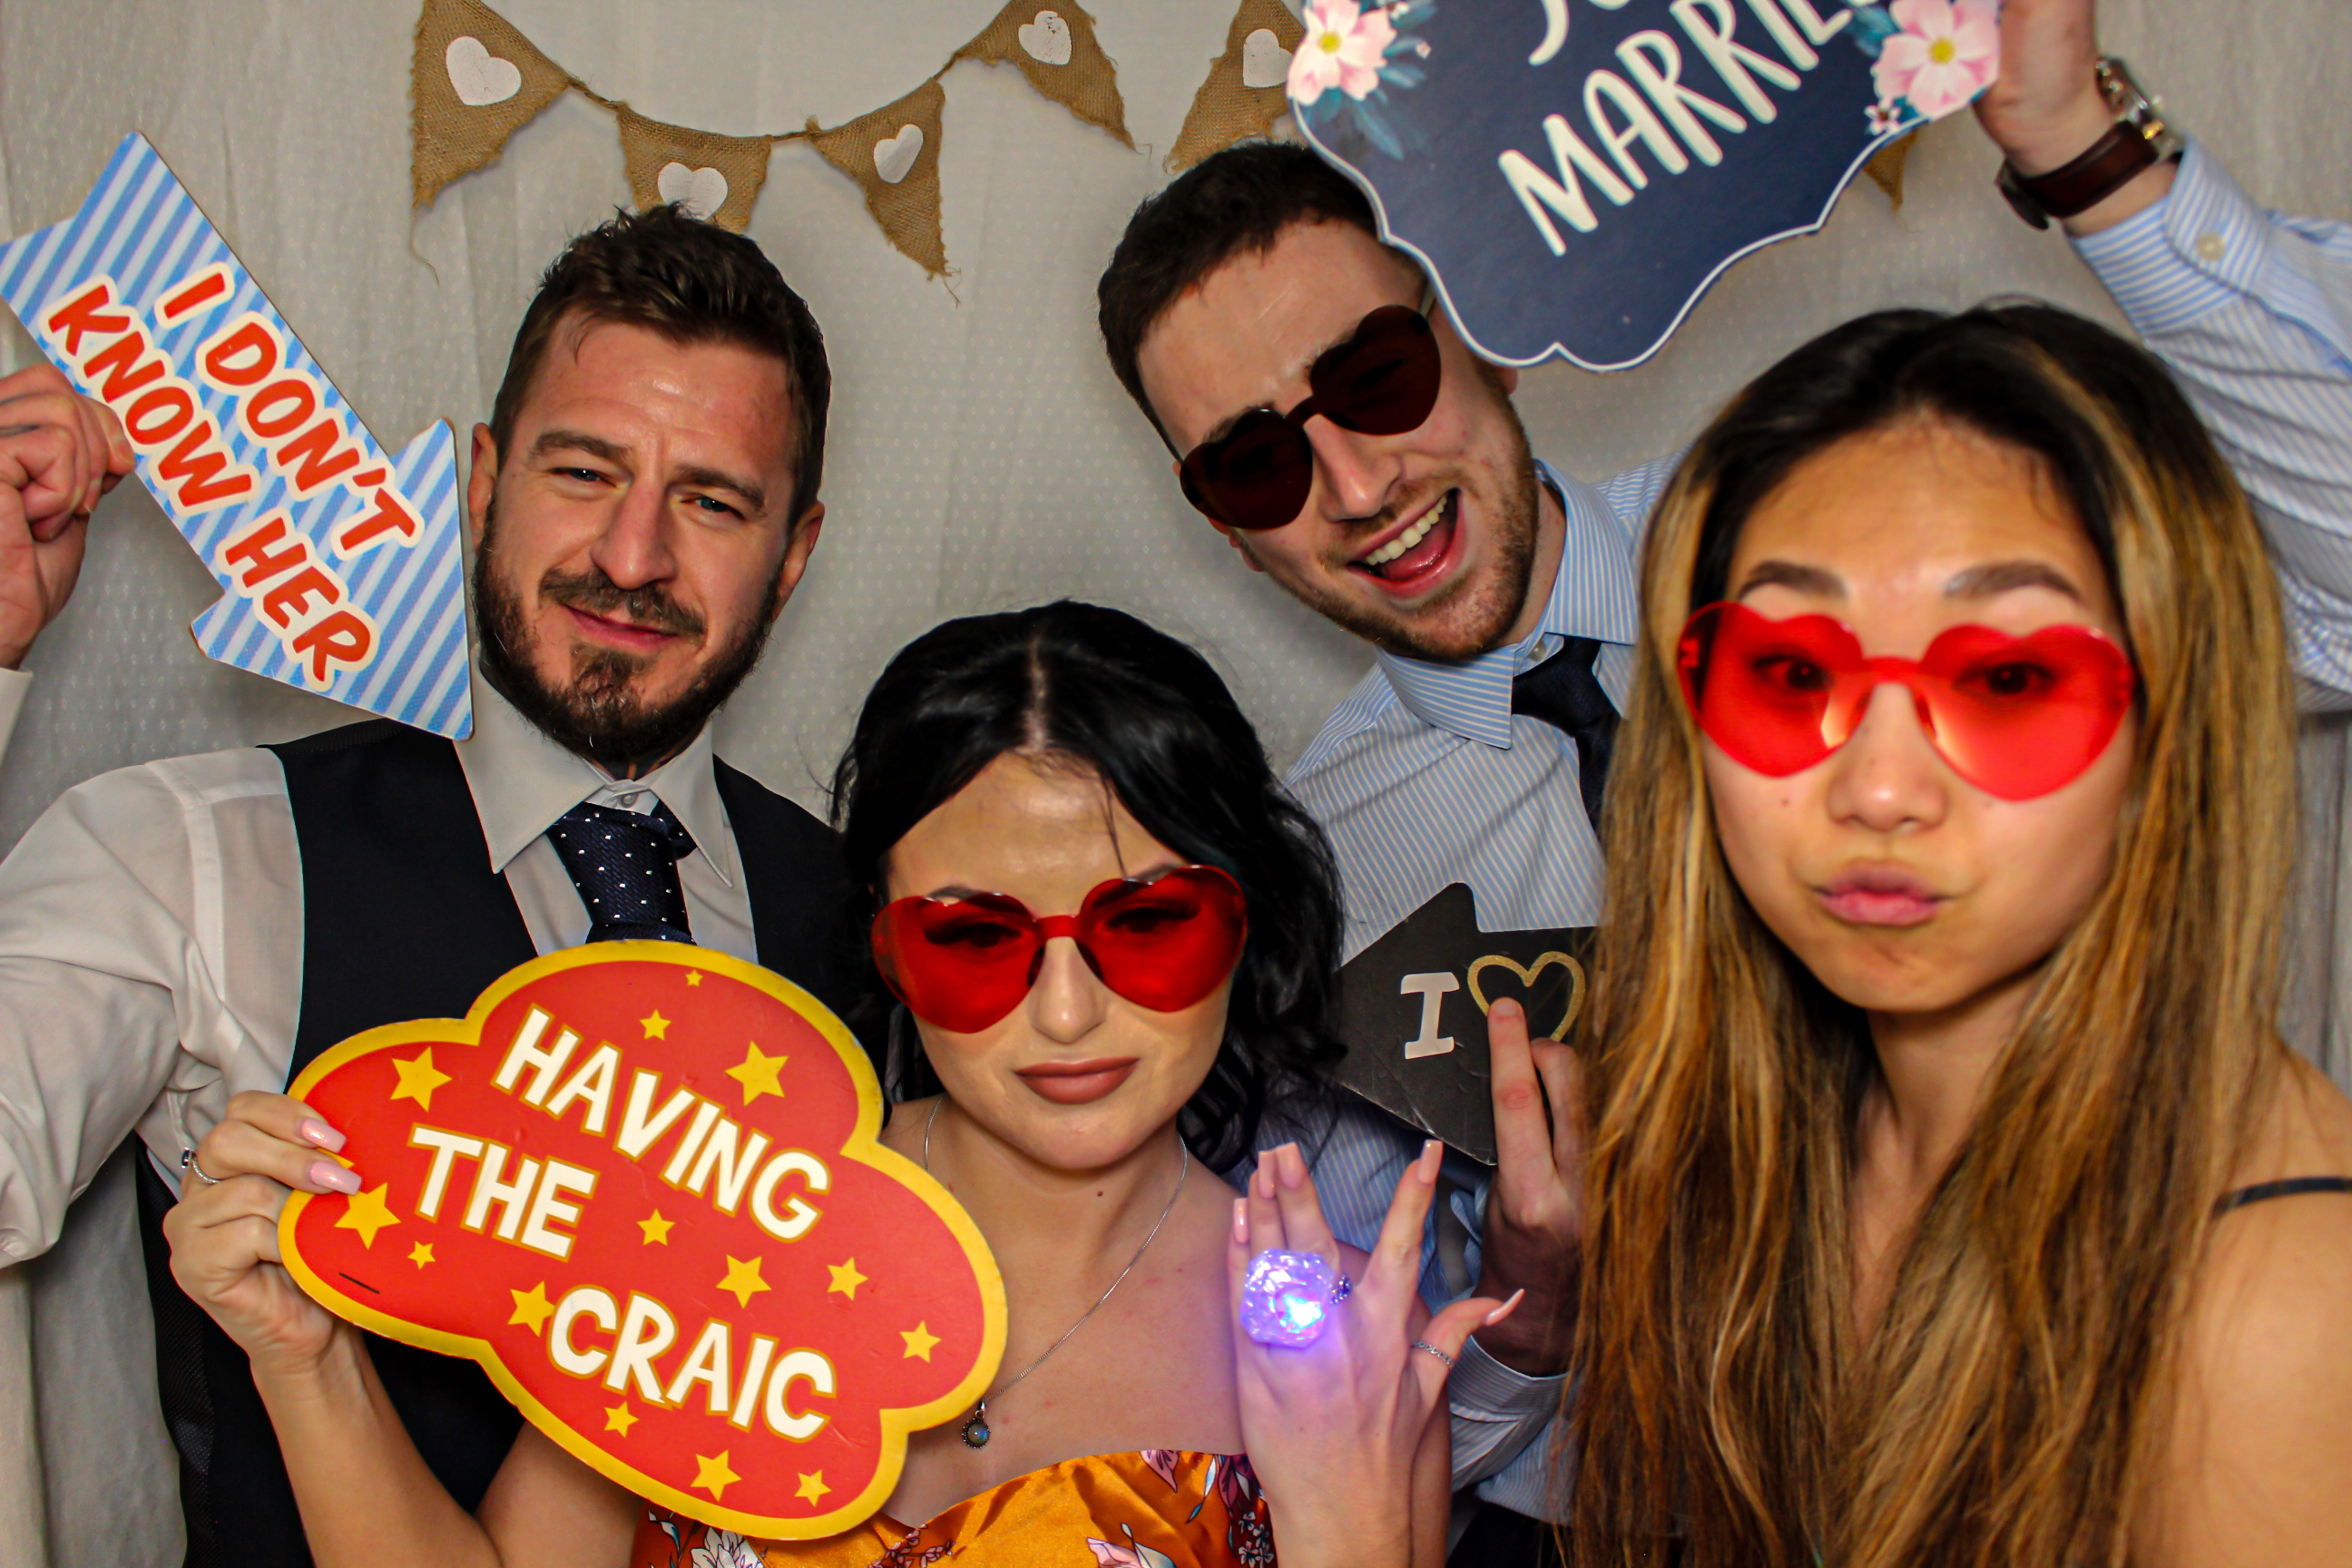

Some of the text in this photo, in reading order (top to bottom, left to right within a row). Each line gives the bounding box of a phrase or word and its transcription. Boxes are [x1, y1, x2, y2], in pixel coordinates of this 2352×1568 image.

[1498, 0, 1875, 256] MARRI
[44, 279, 375, 687] KNOW HER
[160, 267, 420, 555] I DON'T
[493, 1005, 830, 1242] HAVING
[1400, 972, 1460, 1060] I
[410, 1124, 598, 1259] THE
[550, 1286, 837, 1441] CRAIC
